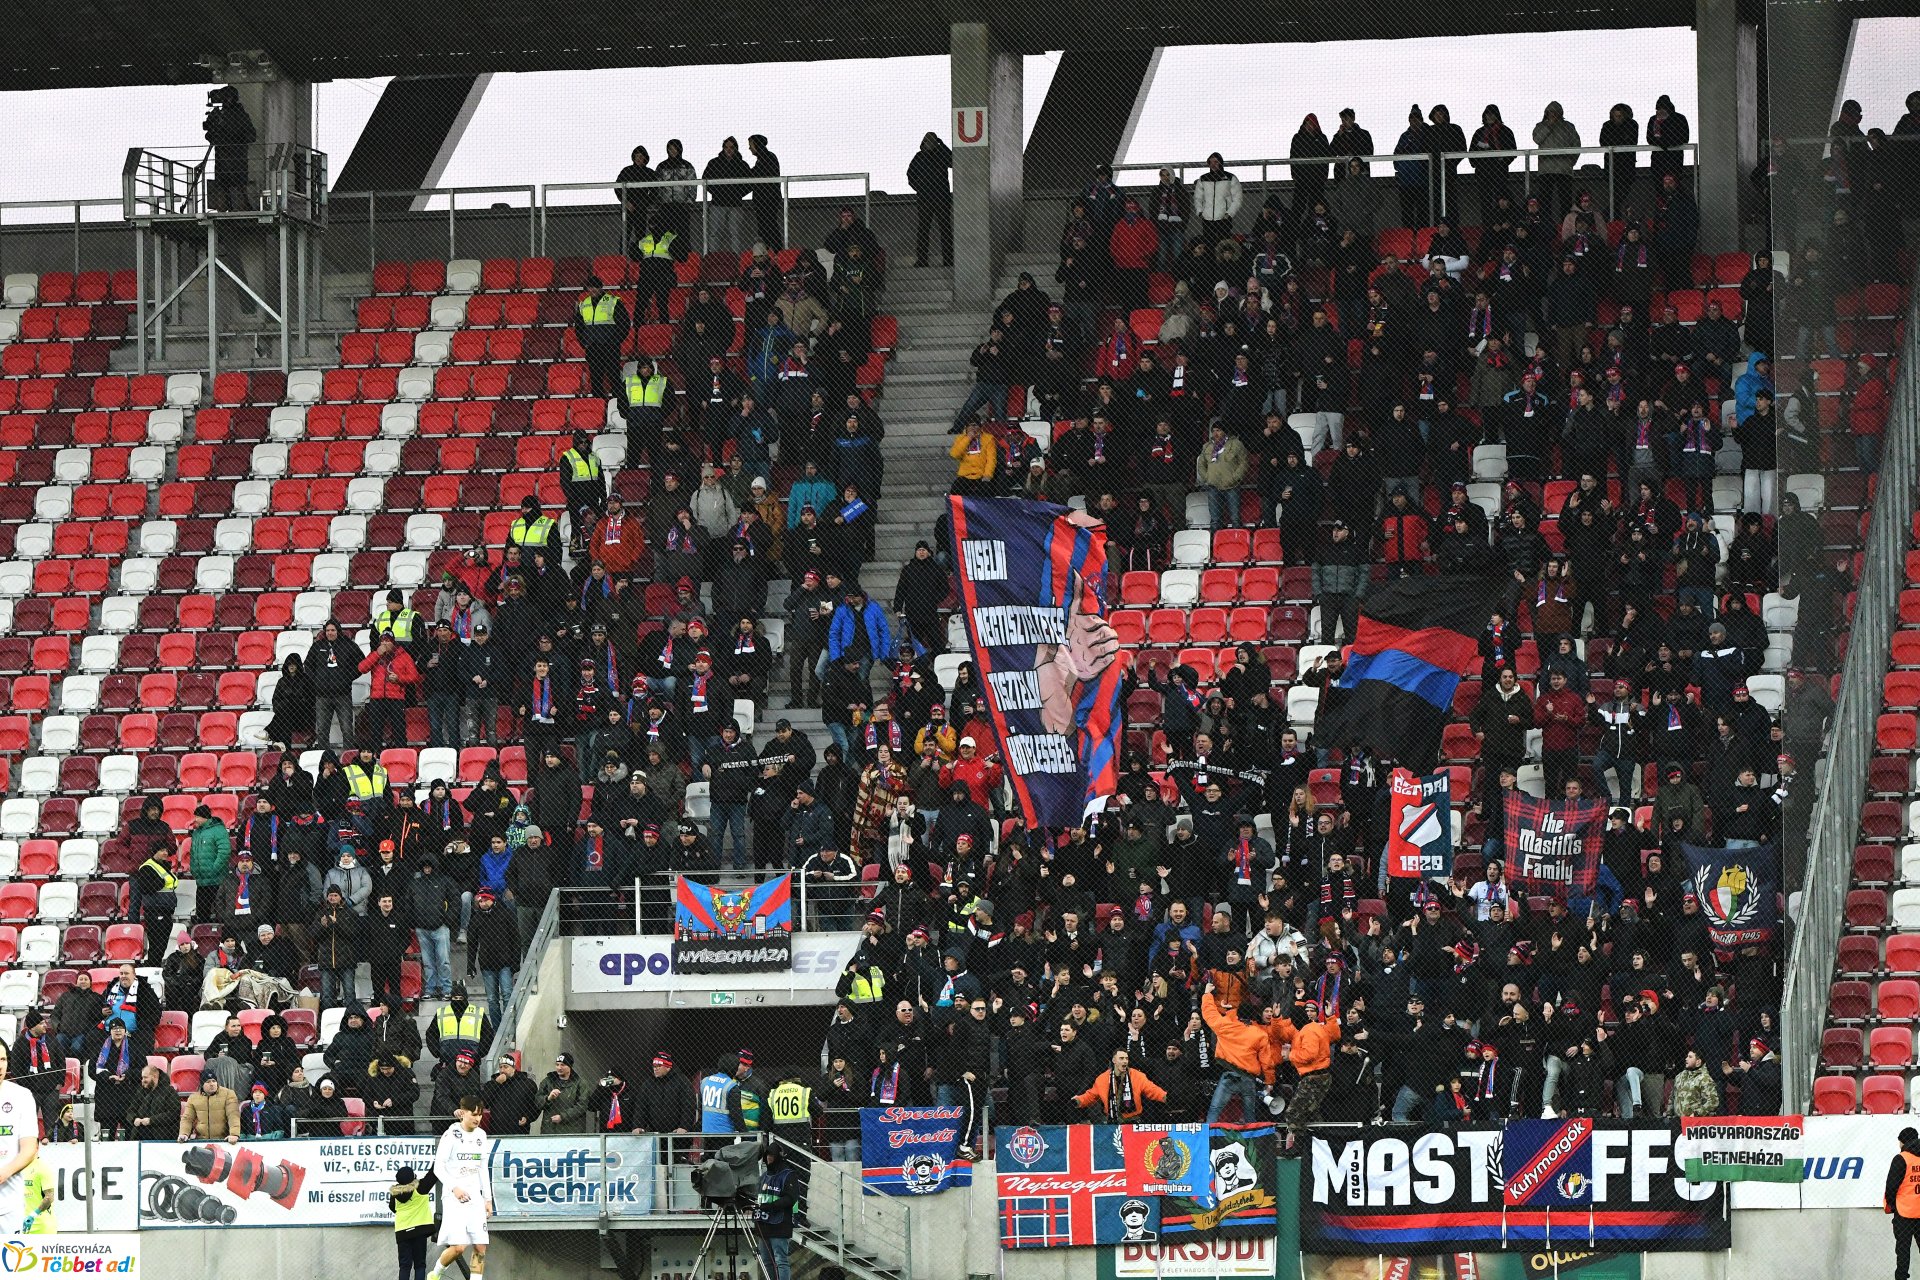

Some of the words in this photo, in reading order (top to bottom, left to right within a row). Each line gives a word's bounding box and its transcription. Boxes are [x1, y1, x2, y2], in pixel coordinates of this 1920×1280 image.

[958, 110, 983, 143] U
[1541, 812, 1566, 833] the
[1519, 828, 1582, 854] Mastiffs
[1400, 855, 1443, 870] 1928
[1522, 854, 1574, 886] Family
[677, 947, 789, 964] NYÍREGYHÁZA
[702, 1085, 723, 1108] 001
[775, 1096, 799, 1116] 106
[879, 1106, 964, 1124] Special
[888, 1128, 957, 1148] Guests
[1686, 1123, 1800, 1141] MAGYARORSZÁG
[320, 1142, 354, 1156] KÁBEL
[358, 1143, 371, 1156] ÉS
[1702, 1149, 1783, 1166] PETNEHÁZA
[324, 1159, 350, 1173] VÍZ-,
[354, 1159, 383, 1173] GÁZ-,
[387, 1159, 400, 1172] ÉS
[503, 1149, 593, 1179] hauff
[1509, 1120, 1587, 1199] Kutymorgók
[1004, 1174, 1126, 1194] Nyíregyhá
[1351, 1150, 1361, 1199] 1995
[308, 1190, 323, 1203] Mi
[328, 1190, 364, 1203] ésszel
[513, 1176, 638, 1204] technik
[1143, 1183, 1192, 1194] Nyíregyháza
[360, 1211, 395, 1219] www.hauff-
